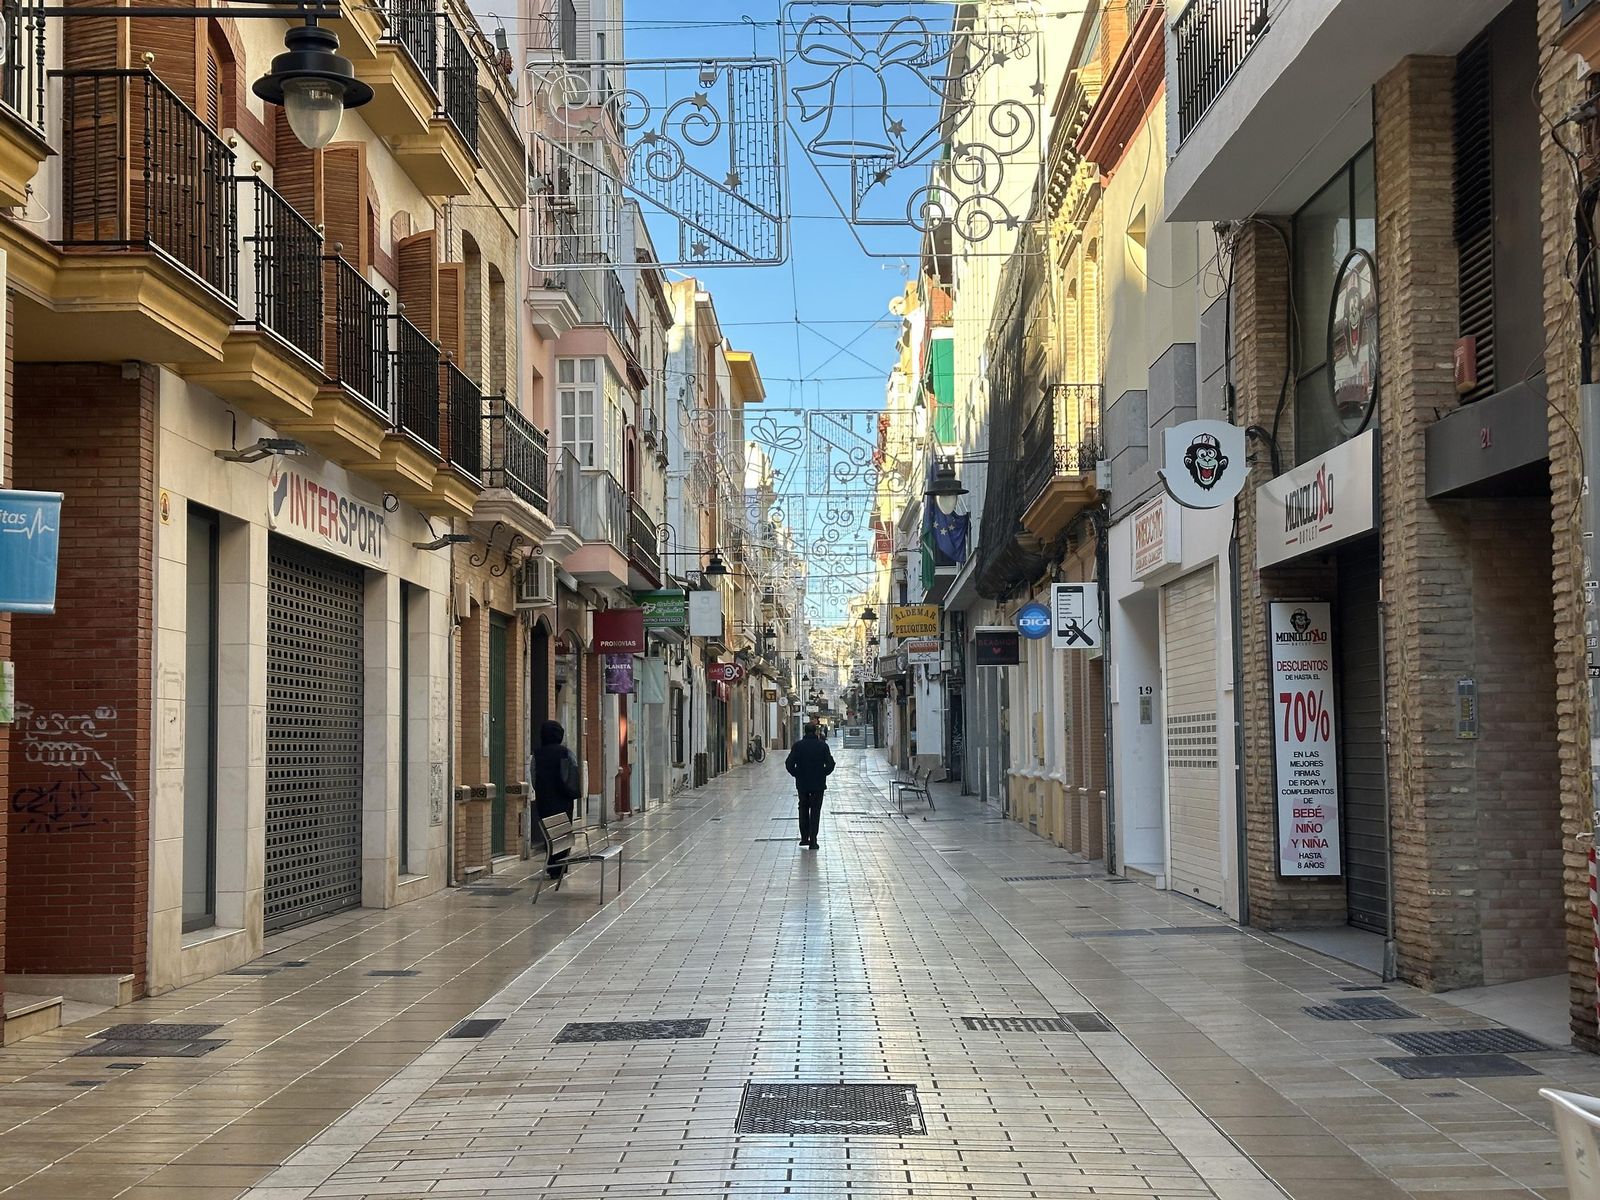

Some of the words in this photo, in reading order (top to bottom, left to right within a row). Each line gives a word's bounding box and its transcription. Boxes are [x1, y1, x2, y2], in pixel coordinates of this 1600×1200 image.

[290, 472, 384, 558] INTERSPORT
[895, 608, 936, 621] ALDEMAR
[1019, 618, 1050, 626] DIGI
[895, 623, 937, 634] PELUQUEROS
[1277, 660, 1328, 671] DESCUENTOS
[1138, 686, 1152, 695] 19
[1280, 690, 1330, 742] 70%
[1293, 805, 1325, 819] BEBÉ,
[1296, 820, 1323, 833] NIÑO
[1291, 839, 1299, 848] Y
[1302, 836, 1329, 848] NIÑA
[1304, 860, 1324, 868] AÑOS
